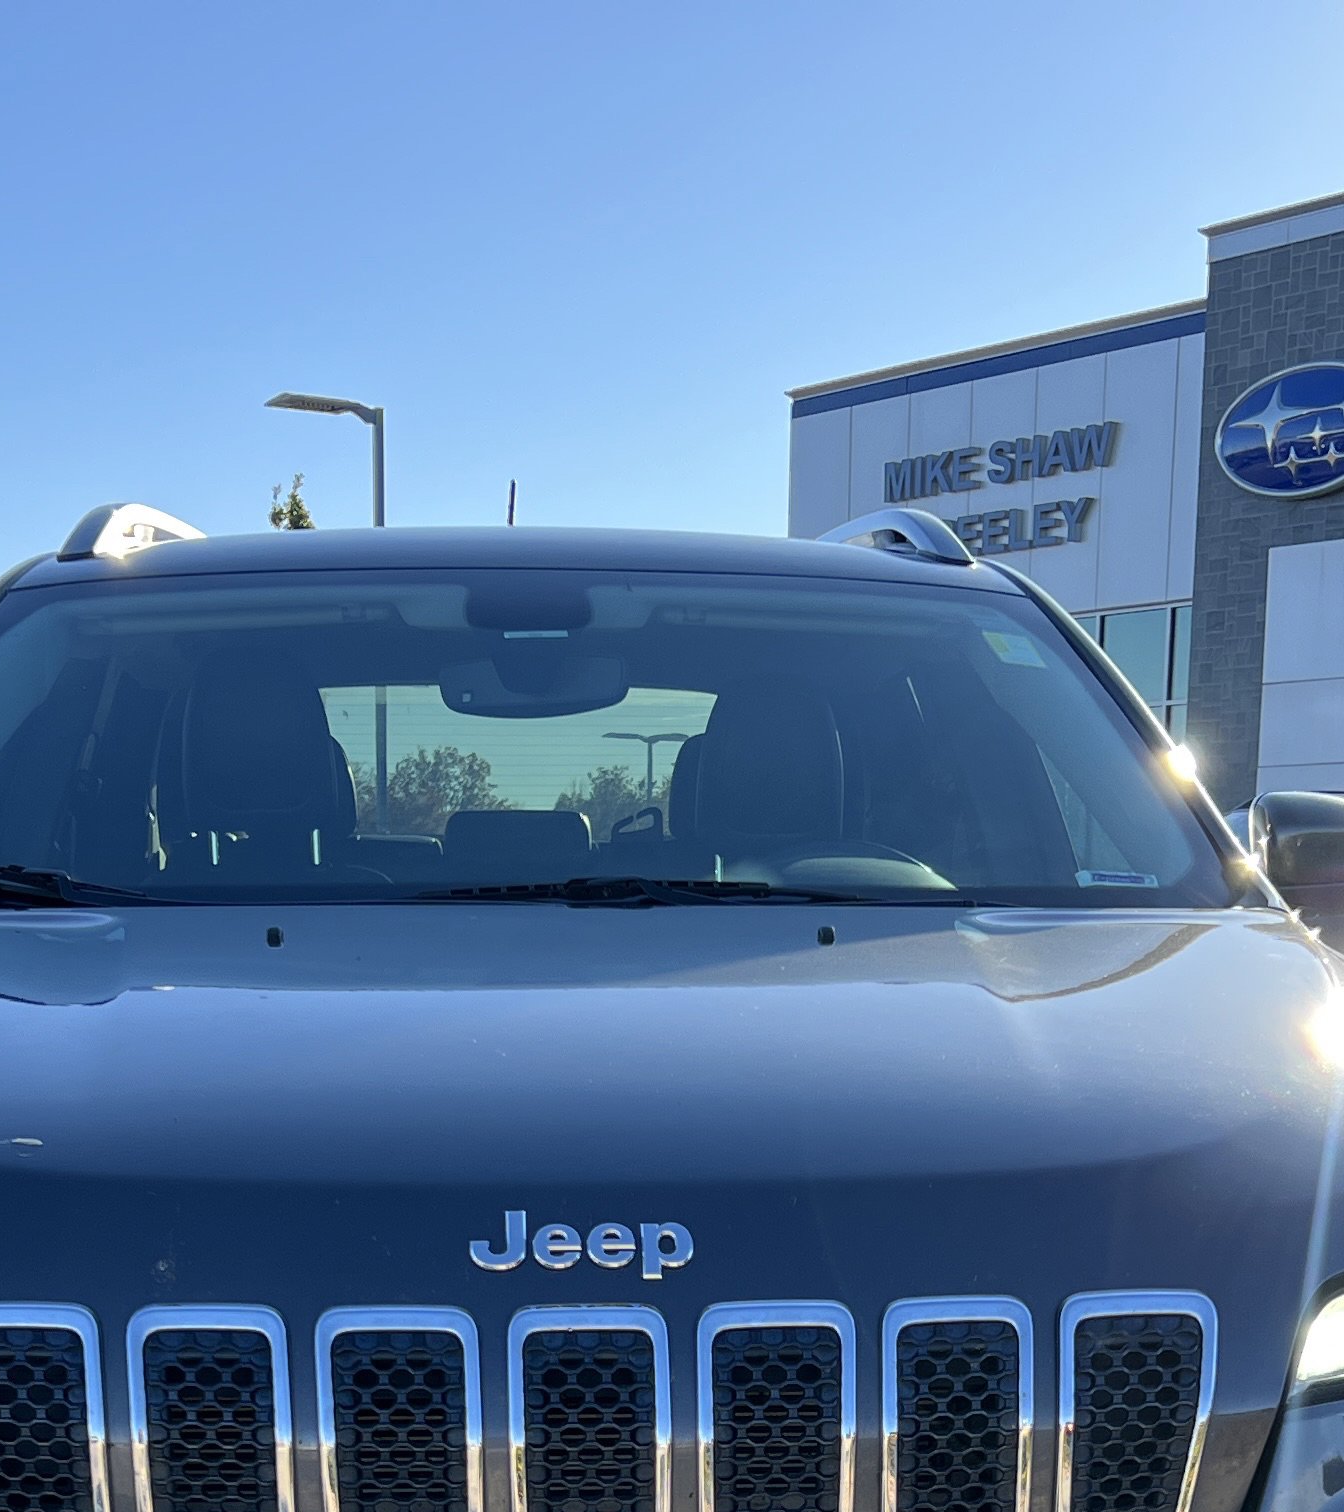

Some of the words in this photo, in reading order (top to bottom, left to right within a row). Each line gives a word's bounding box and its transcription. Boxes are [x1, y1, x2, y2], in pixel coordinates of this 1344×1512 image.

[883, 446, 982, 503] MIKE
[987, 421, 1120, 484] SHAW
[943, 497, 1094, 556] EELEY
[469, 1210, 694, 1279] Jeep
